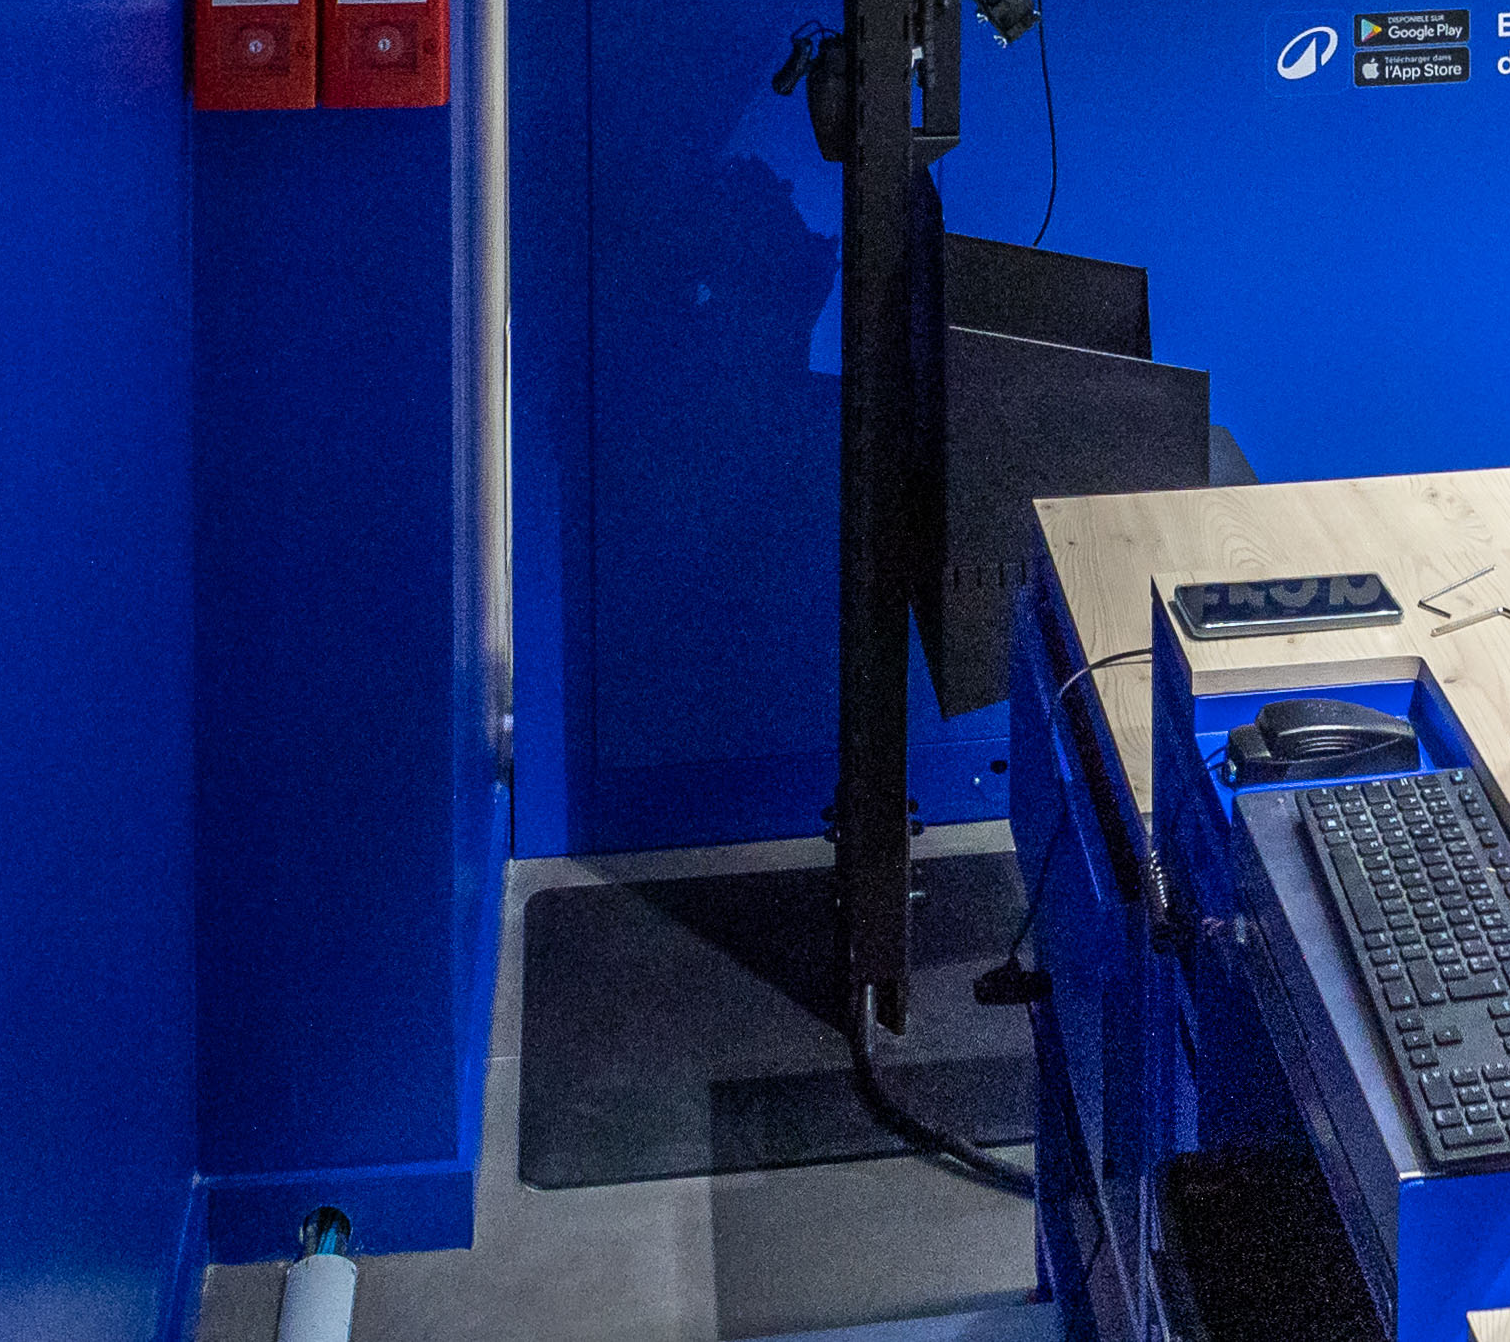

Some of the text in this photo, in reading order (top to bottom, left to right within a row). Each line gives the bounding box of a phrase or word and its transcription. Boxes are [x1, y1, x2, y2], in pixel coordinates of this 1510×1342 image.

[1388, 14, 1445, 24] DISPONIBLE SUR
[1388, 24, 1462, 40] Google Play
[1385, 56, 1432, 64] Télécharger
[1385, 63, 1462, 80] l’App Store
